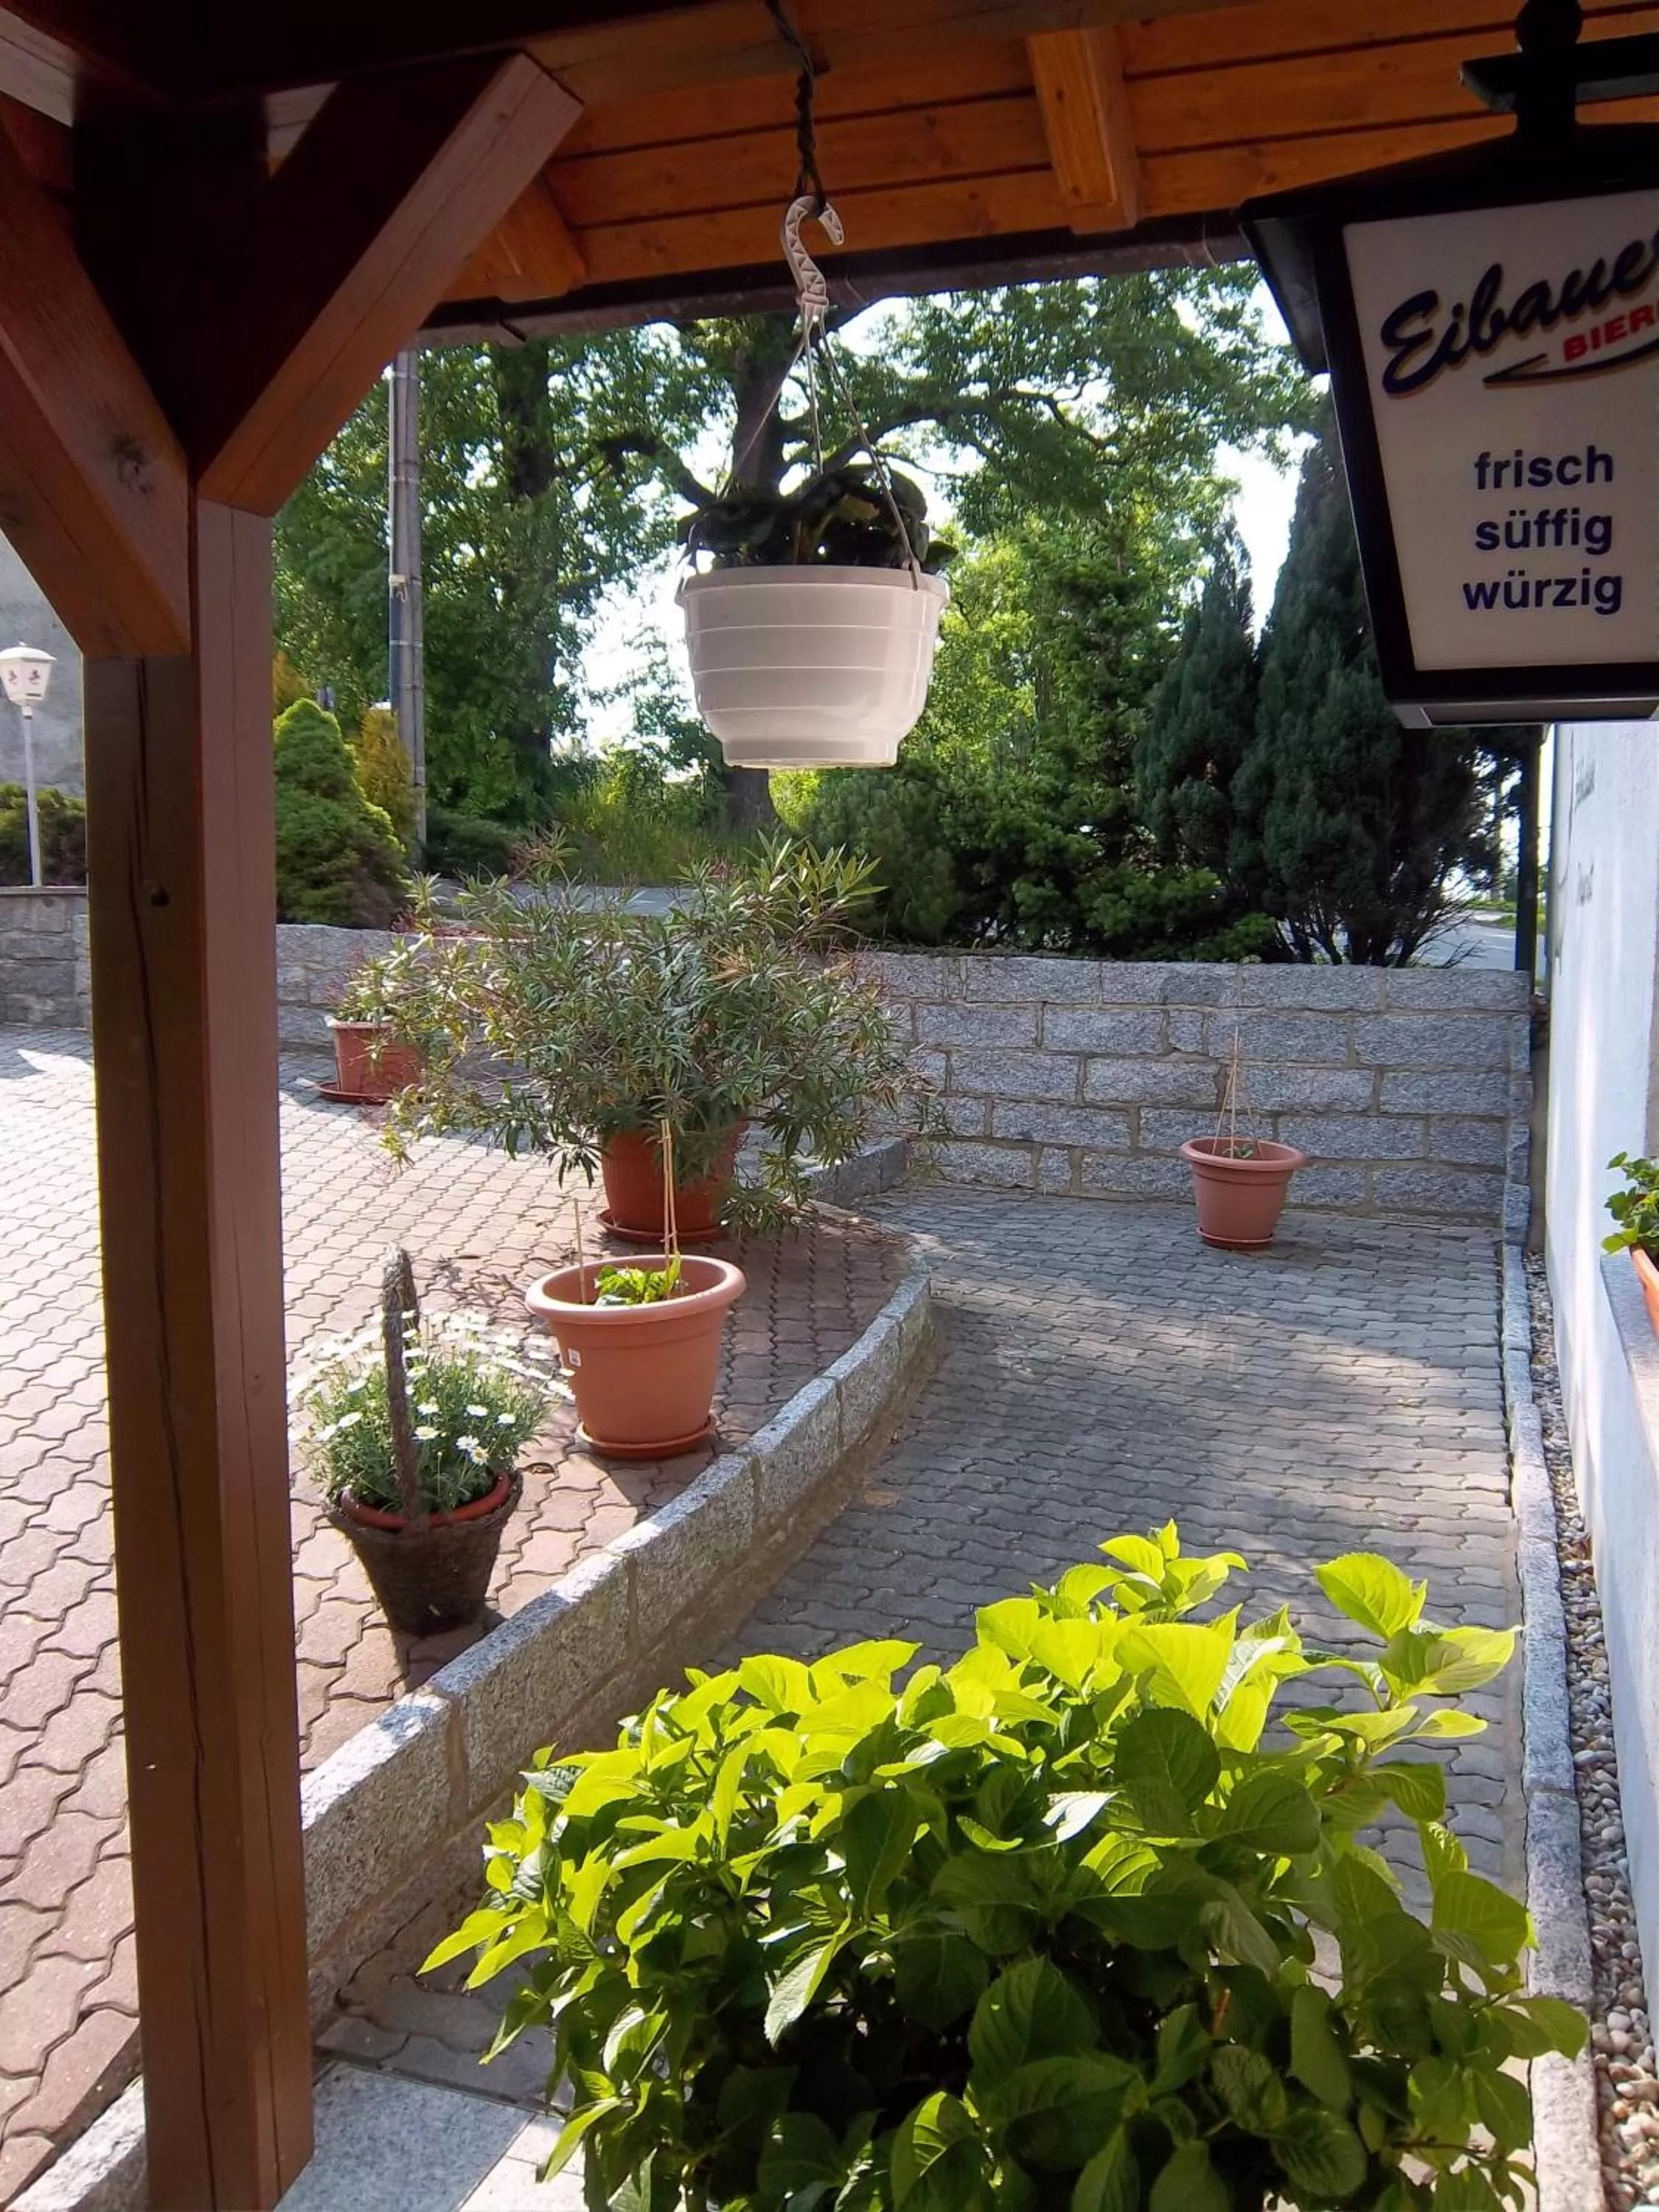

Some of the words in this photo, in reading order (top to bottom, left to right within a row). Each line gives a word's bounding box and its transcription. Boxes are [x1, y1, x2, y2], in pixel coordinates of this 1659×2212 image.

[1562, 299, 1659, 364] BIER
[1474, 445, 1614, 490] frisch
[1475, 507, 1613, 555] süffig
[1462, 567, 1622, 615] würzig
